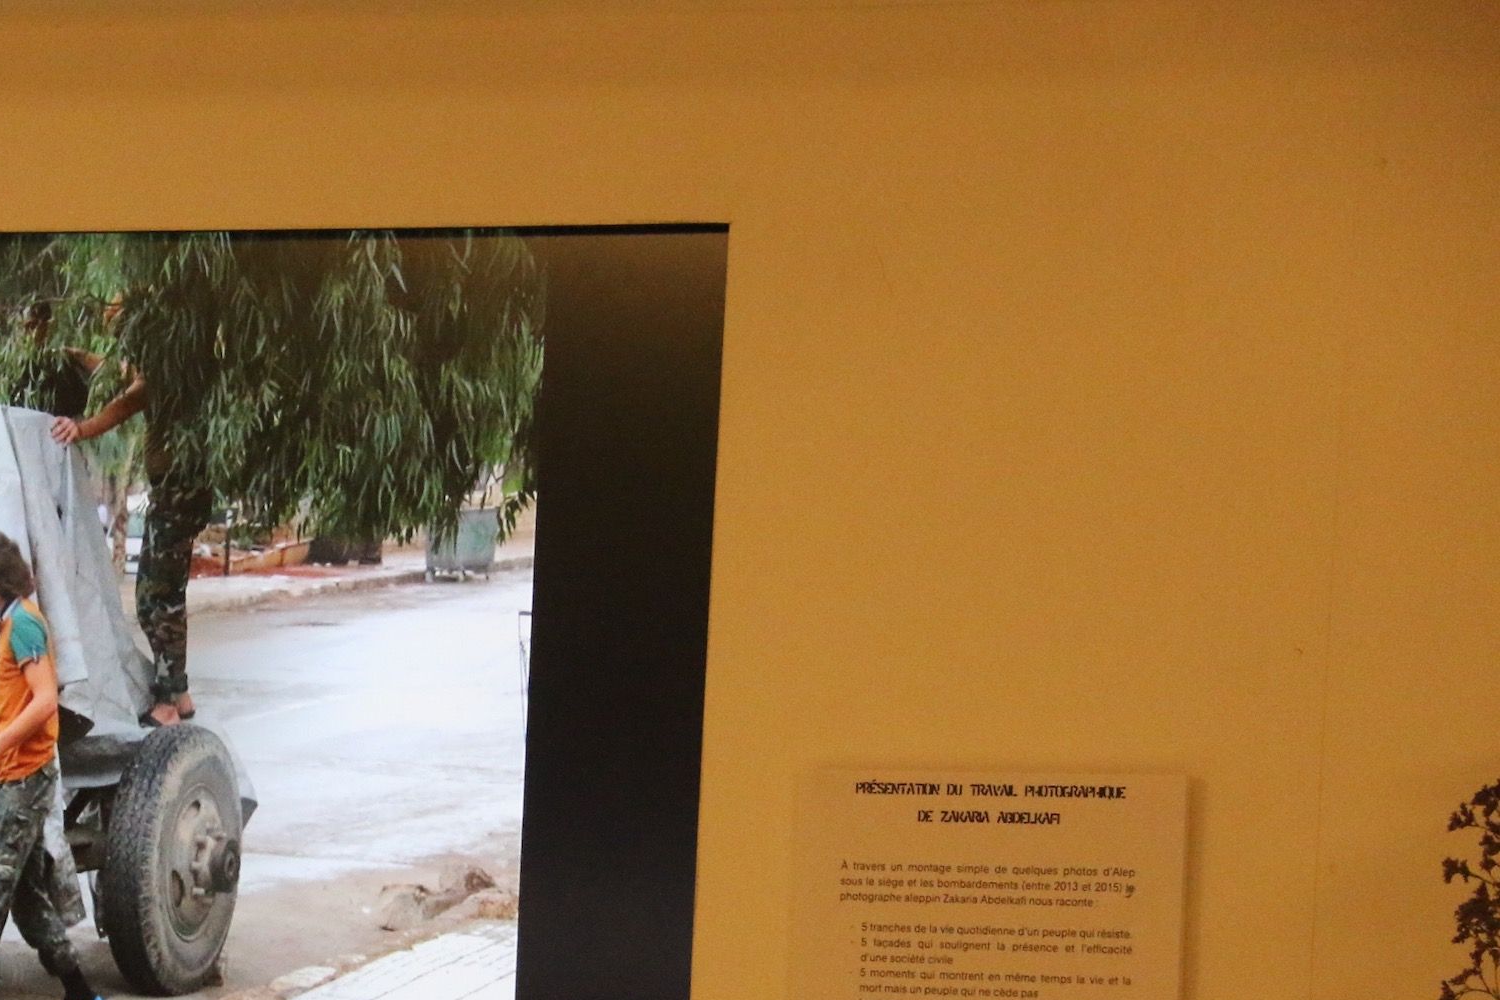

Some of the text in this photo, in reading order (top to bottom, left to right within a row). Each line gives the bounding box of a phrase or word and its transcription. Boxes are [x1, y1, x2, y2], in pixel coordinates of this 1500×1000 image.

[856, 779, 1126, 799] PRÉSENTATION DU TRAVAIL PHOTOGRAPHIQUE
[917, 809, 1060, 824] DE ZAKARIA ABDELKAFI
[853, 861, 886, 872] travers
[908, 862, 952, 875] montage
[956, 863, 989, 876] simple
[1012, 864, 1058, 877] quelques
[1063, 865, 1098, 878] photos
[1103, 866, 1136, 879] d'Alep
[840, 878, 863, 887] sous
[920, 878, 934, 888] les
[937, 878, 1018, 890] bombardements
[1022, 880, 1050, 892] (entre
[1053, 880, 1078, 891] 2013
[1094, 881, 1122, 894] 2015)
[839, 891, 1093, 906] photographe aleppin Zakaria Abdelkafi nous raconte
[870, 922, 911, 933] tranches
[940, 924, 954, 934] vie
[957, 924, 1016, 938] quotidienne
[1018, 926, 1039, 936] d'un
[1042, 926, 1077, 939] peuple
[1079, 928, 1094, 940] qui
[918, 939, 933, 951] qui
[940, 939, 990, 953] soulignent
[1012, 941, 1058, 955] présence
[860, 952, 953, 964] d'une société civile
[870, 968, 915, 979] moments
[920, 970, 935, 982] qui
[939, 970, 984, 981] montrent
[1041, 973, 1072, 986] temps
[1090, 974, 1104, 984] vie
[859, 983, 882, 994] mort
[884, 984, 907, 994] mais
[924, 985, 958, 998] peuple
[961, 986, 976, 998] qui
[1021, 989, 1039, 1000] pas
